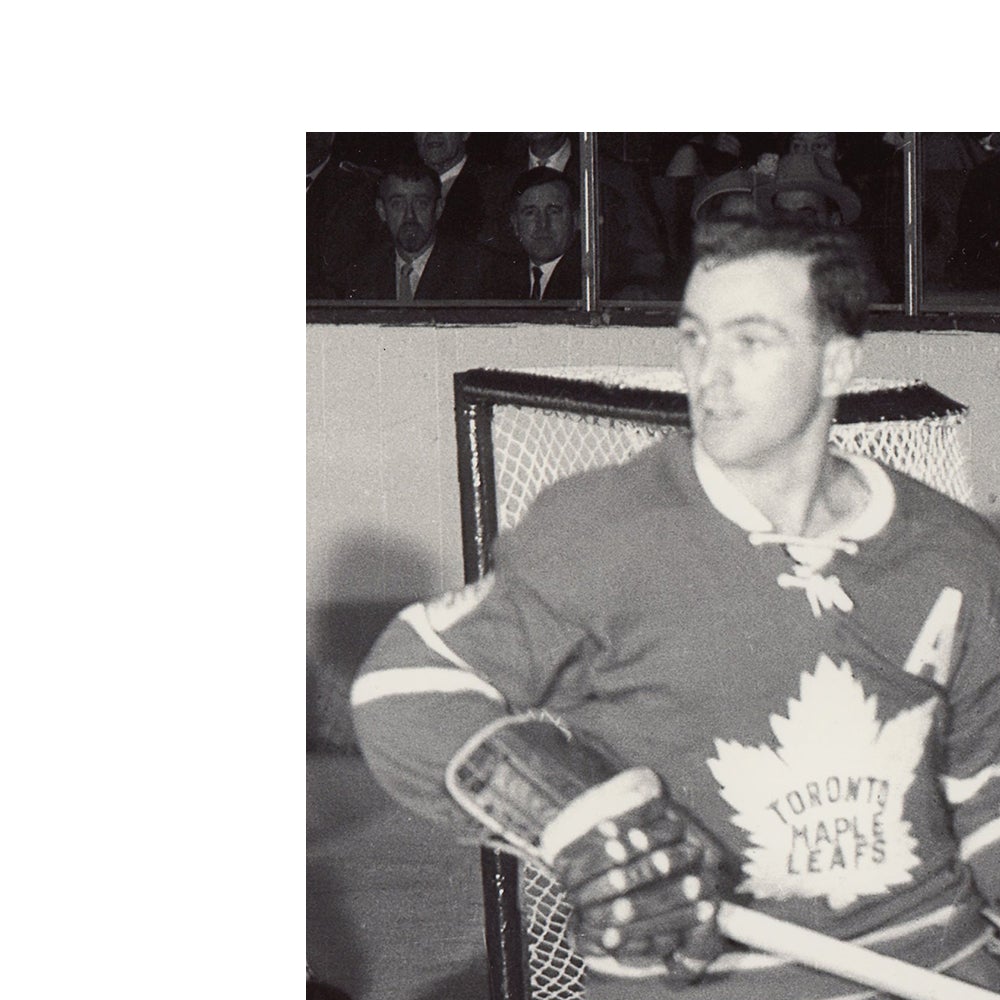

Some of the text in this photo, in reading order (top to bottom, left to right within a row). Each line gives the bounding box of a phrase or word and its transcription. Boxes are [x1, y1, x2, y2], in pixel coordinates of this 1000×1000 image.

[903, 586, 963, 686] A
[765, 776, 889, 824] TORONTO
[791, 811, 884, 849] MAPLE
[787, 840, 886, 875] LEAFS
